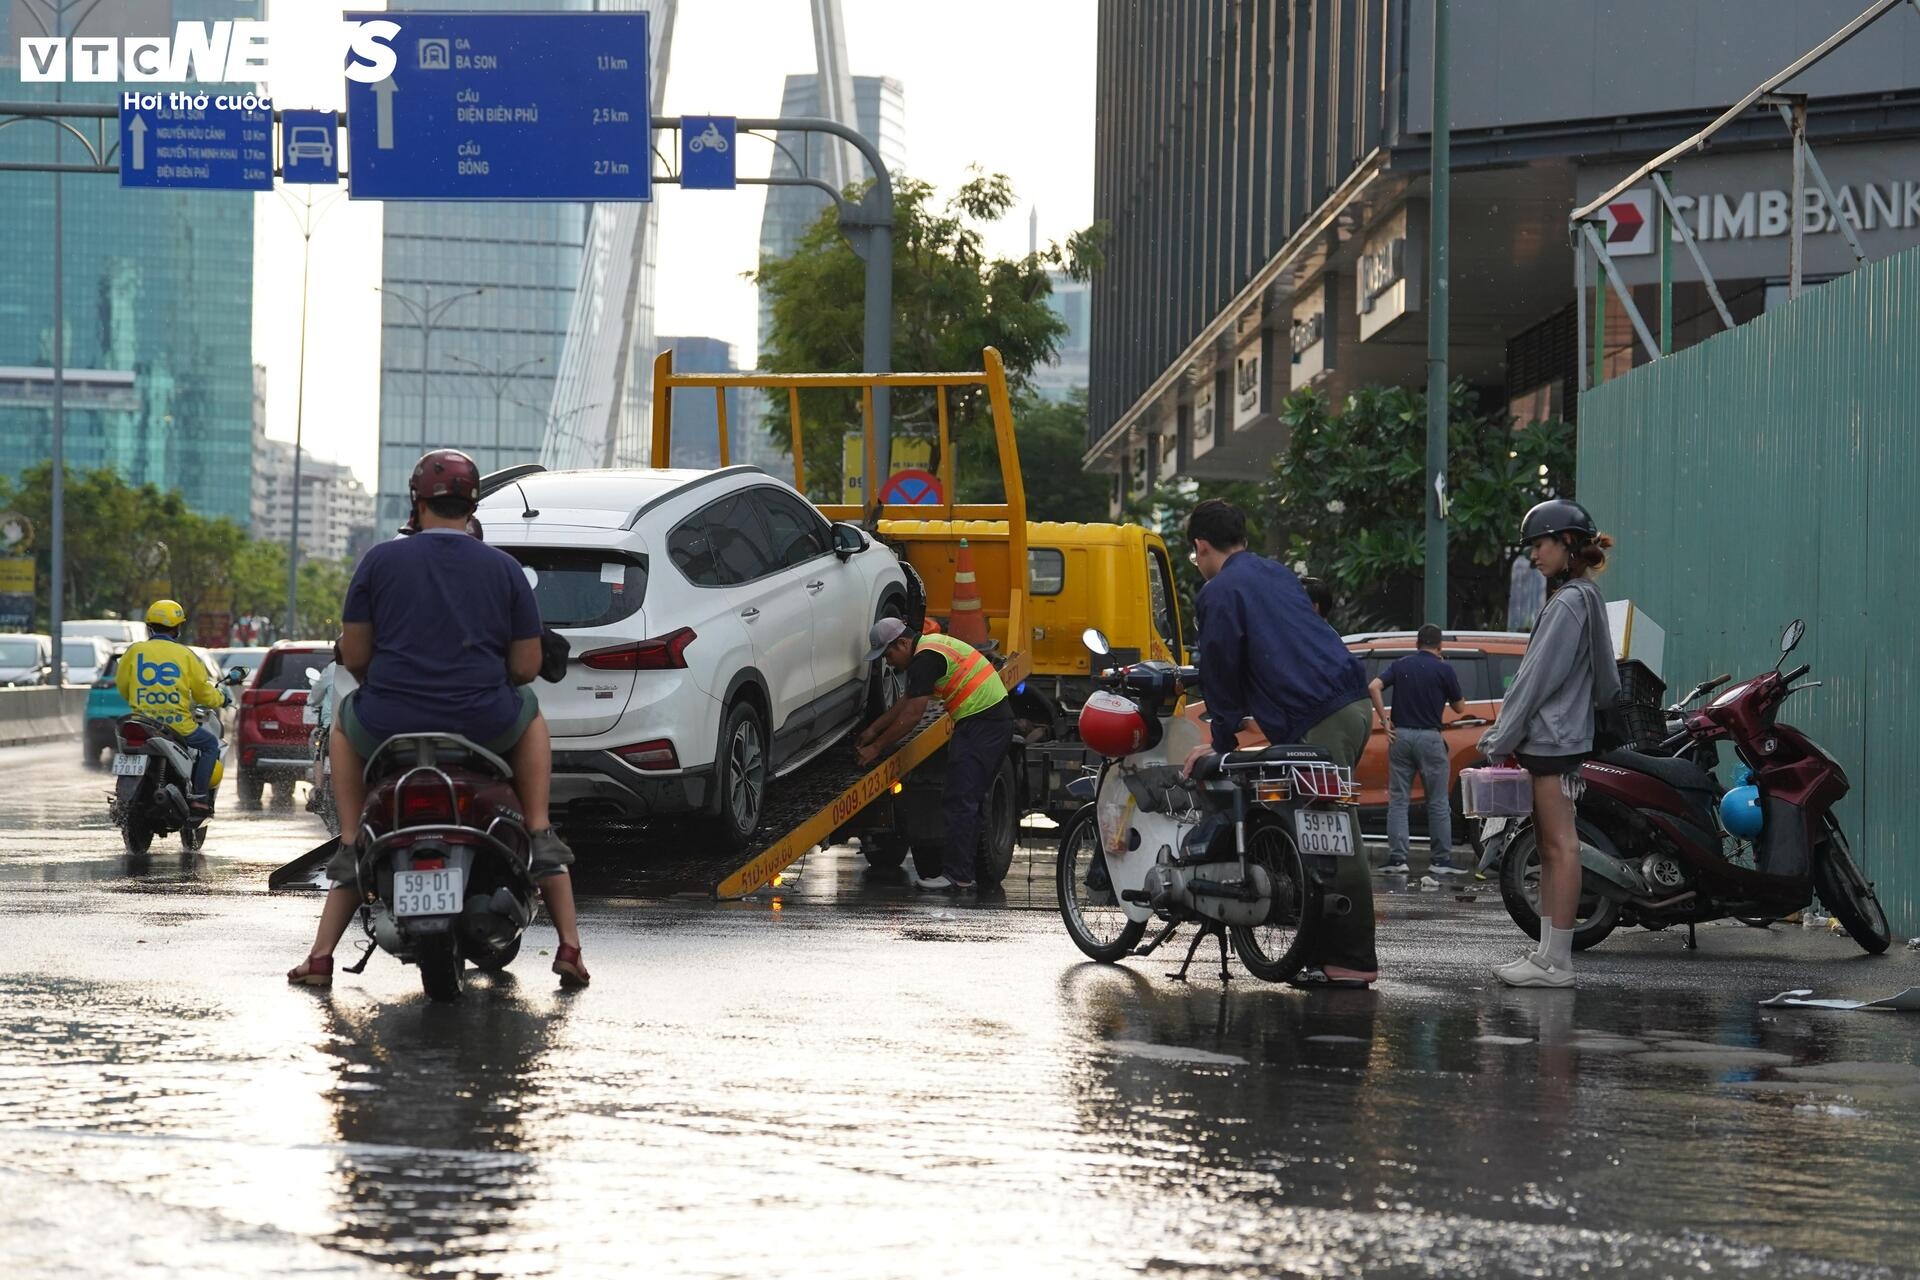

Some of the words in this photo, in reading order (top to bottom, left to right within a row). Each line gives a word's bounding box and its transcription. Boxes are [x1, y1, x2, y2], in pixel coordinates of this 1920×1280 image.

[455, 38, 471, 50] GA
[456, 55, 471, 69] BA
[610, 56, 628, 70] km
[611, 108, 629, 122] km
[611, 161, 629, 174] km
[137, 653, 181, 687] be
[1303, 813, 1343, 833] 59-PA
[1301, 833, 1349, 853] 000.21
[404, 873, 450, 893] 59-D1
[399, 892, 456, 912] 530.51
